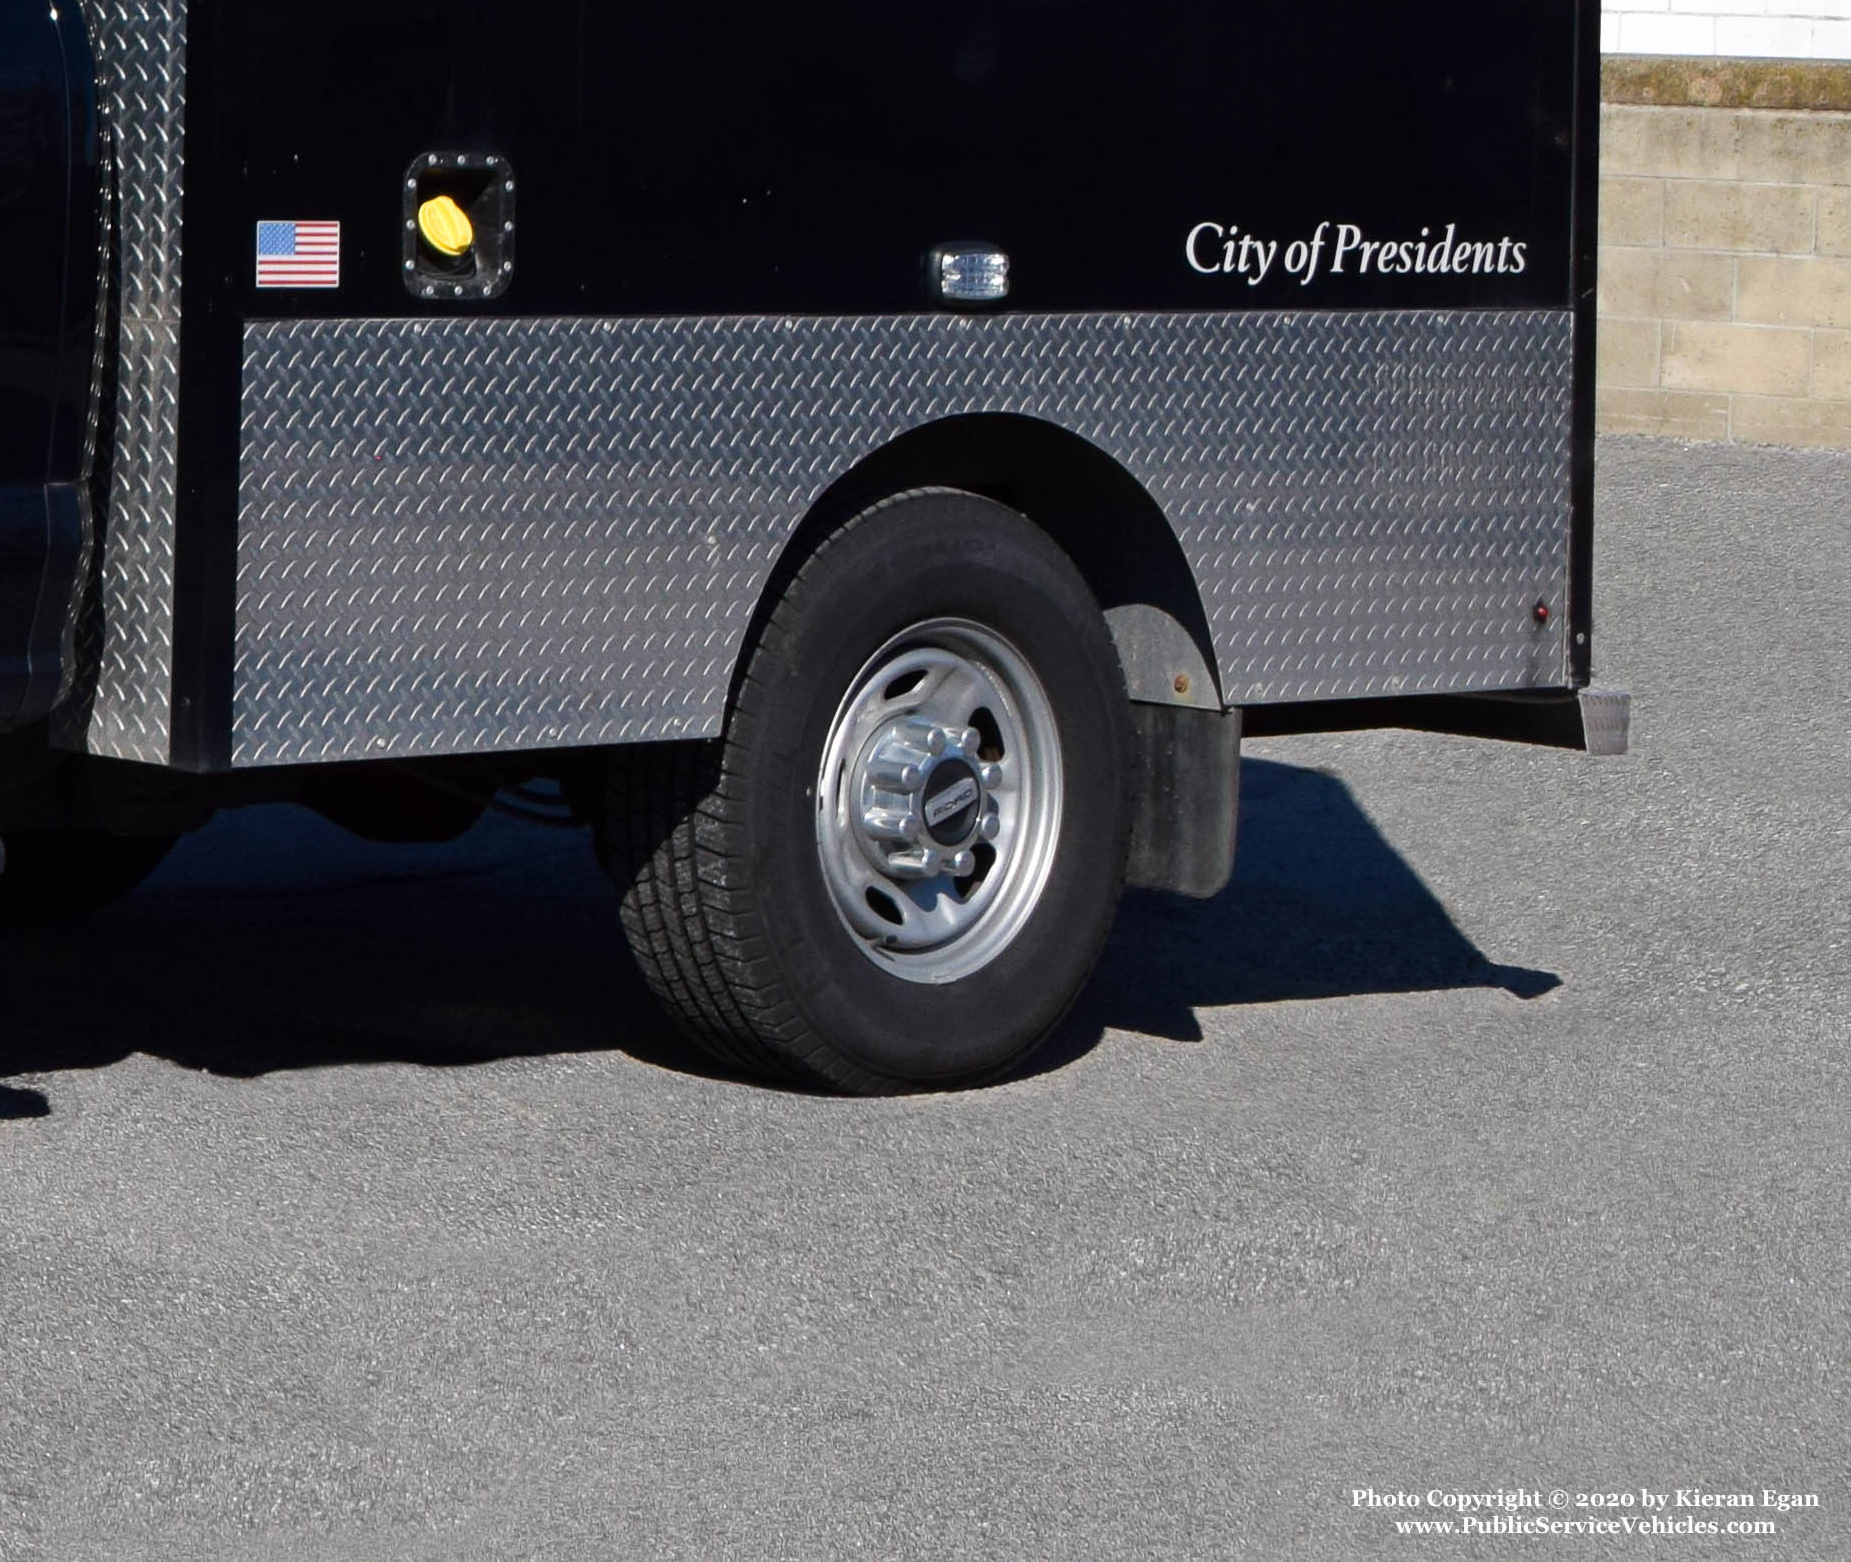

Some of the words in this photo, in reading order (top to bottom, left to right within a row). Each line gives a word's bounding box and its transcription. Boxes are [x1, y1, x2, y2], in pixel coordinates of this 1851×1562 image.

[1185, 221, 1281, 286] City
[1284, 221, 1330, 286] of
[1329, 222, 1527, 276] Presidents
